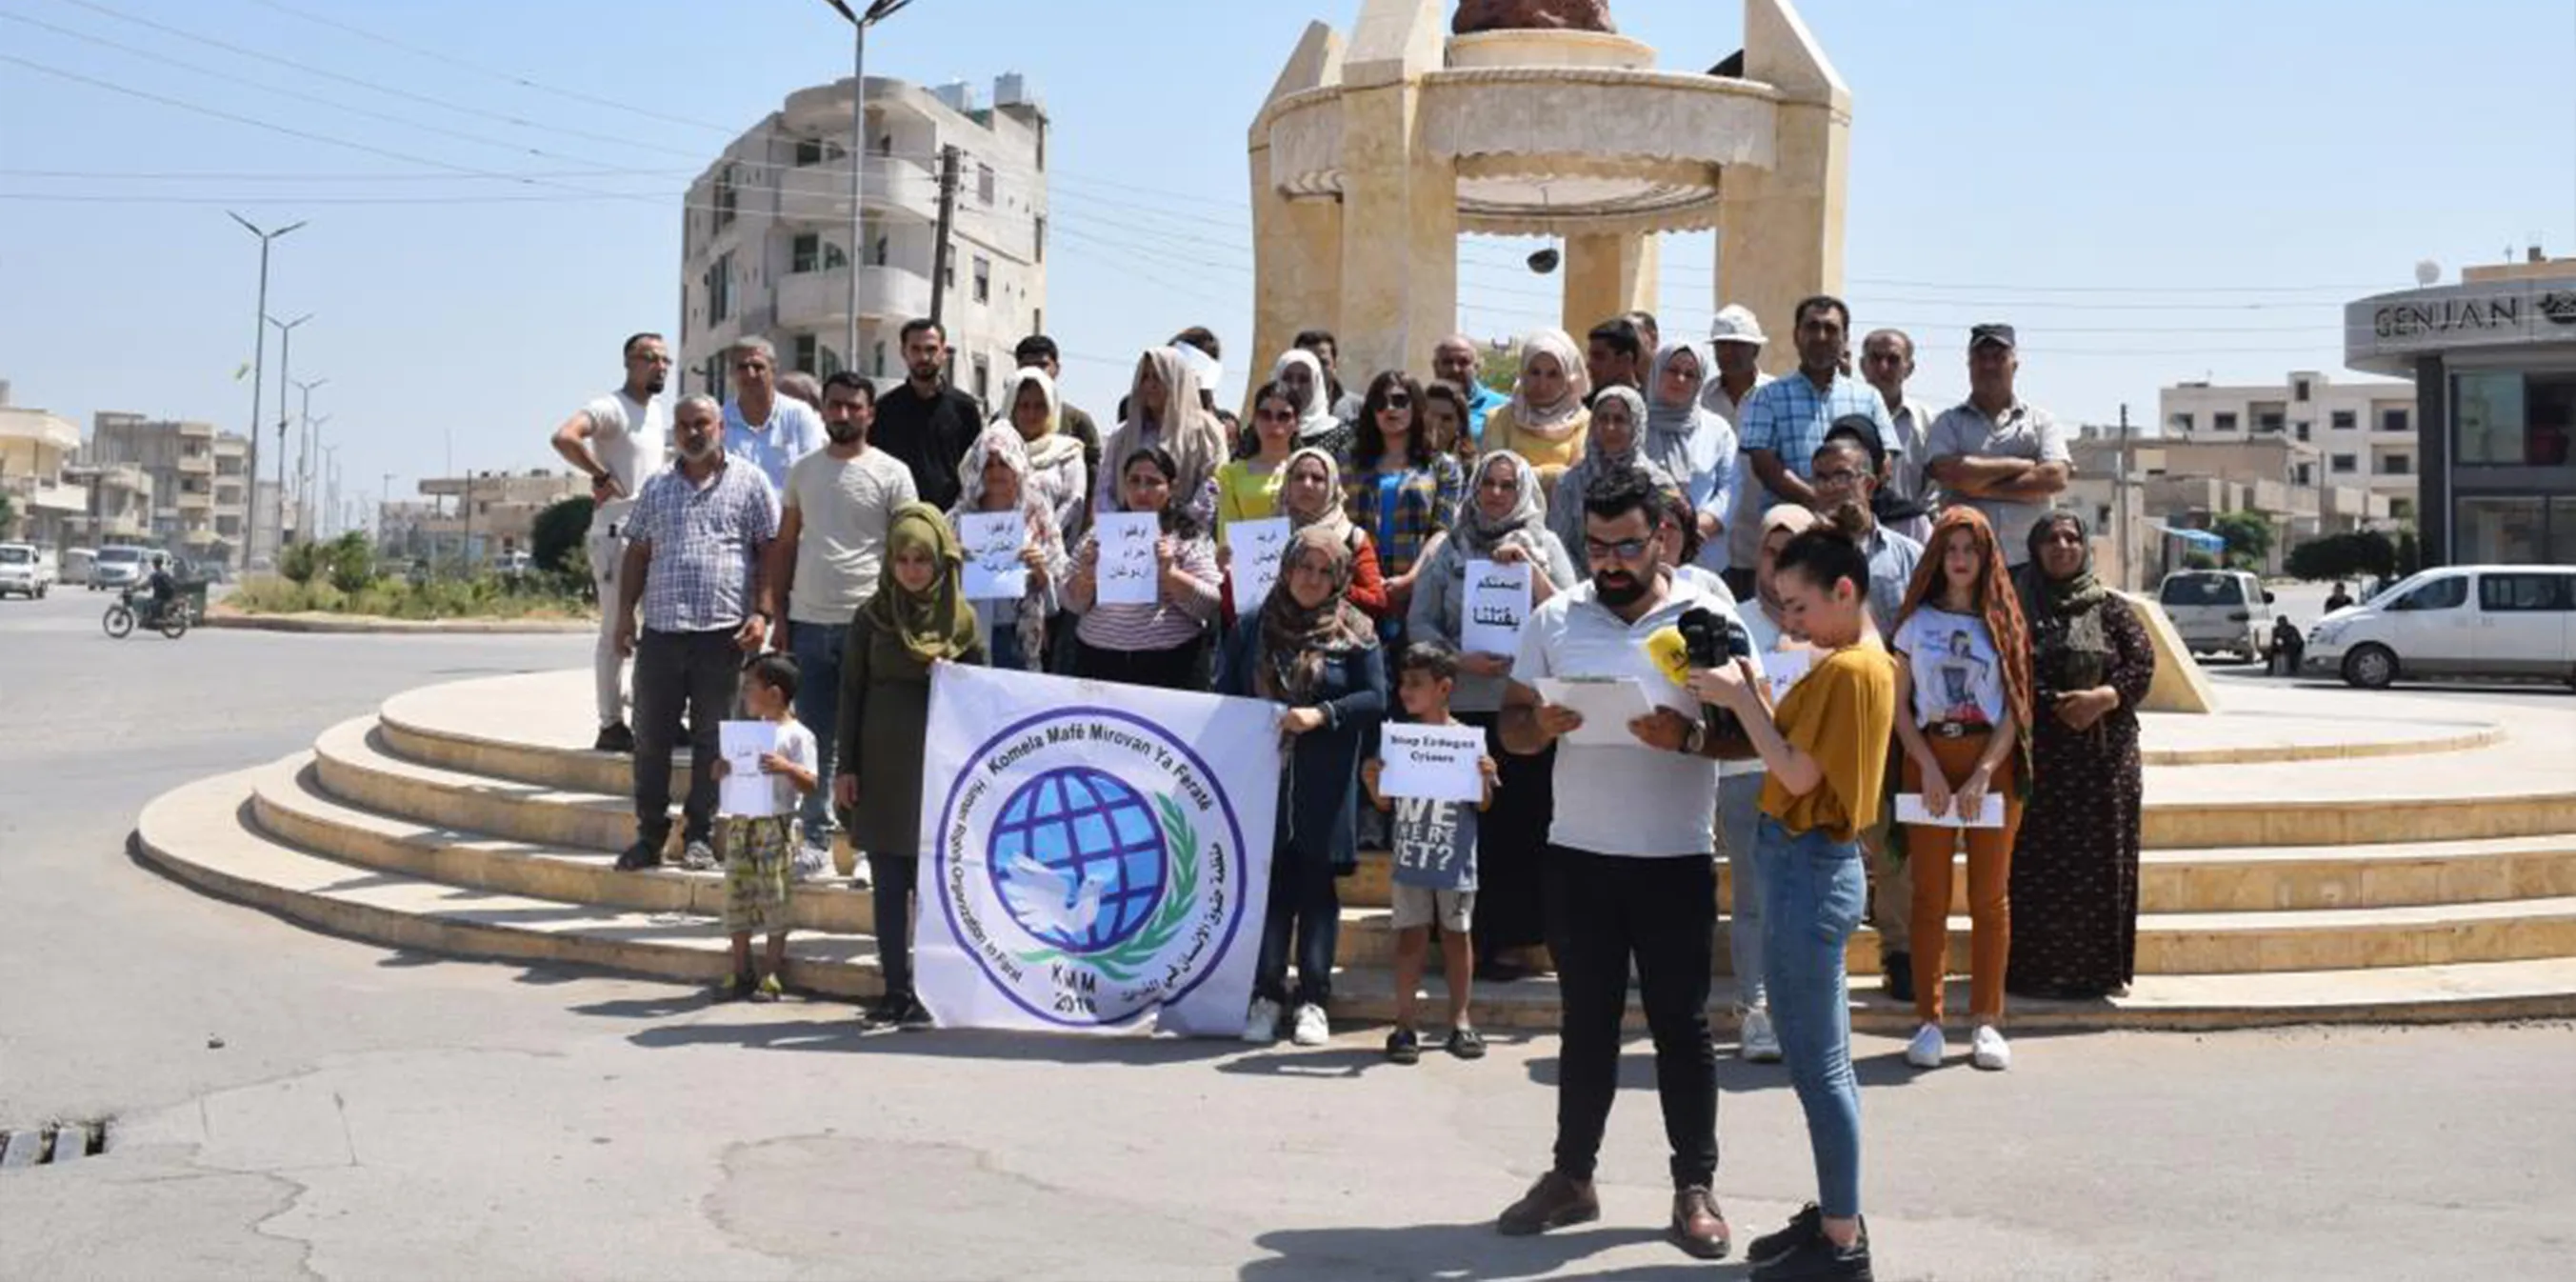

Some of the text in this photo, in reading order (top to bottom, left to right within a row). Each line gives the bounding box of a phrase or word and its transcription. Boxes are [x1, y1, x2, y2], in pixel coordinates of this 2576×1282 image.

[2374, 297, 2517, 338] GENJAN
[987, 734, 1045, 776] Komela
[1089, 723, 1150, 755] Mirovan
[1154, 746, 1174, 771] Ya
[1395, 797, 1458, 828] WE
